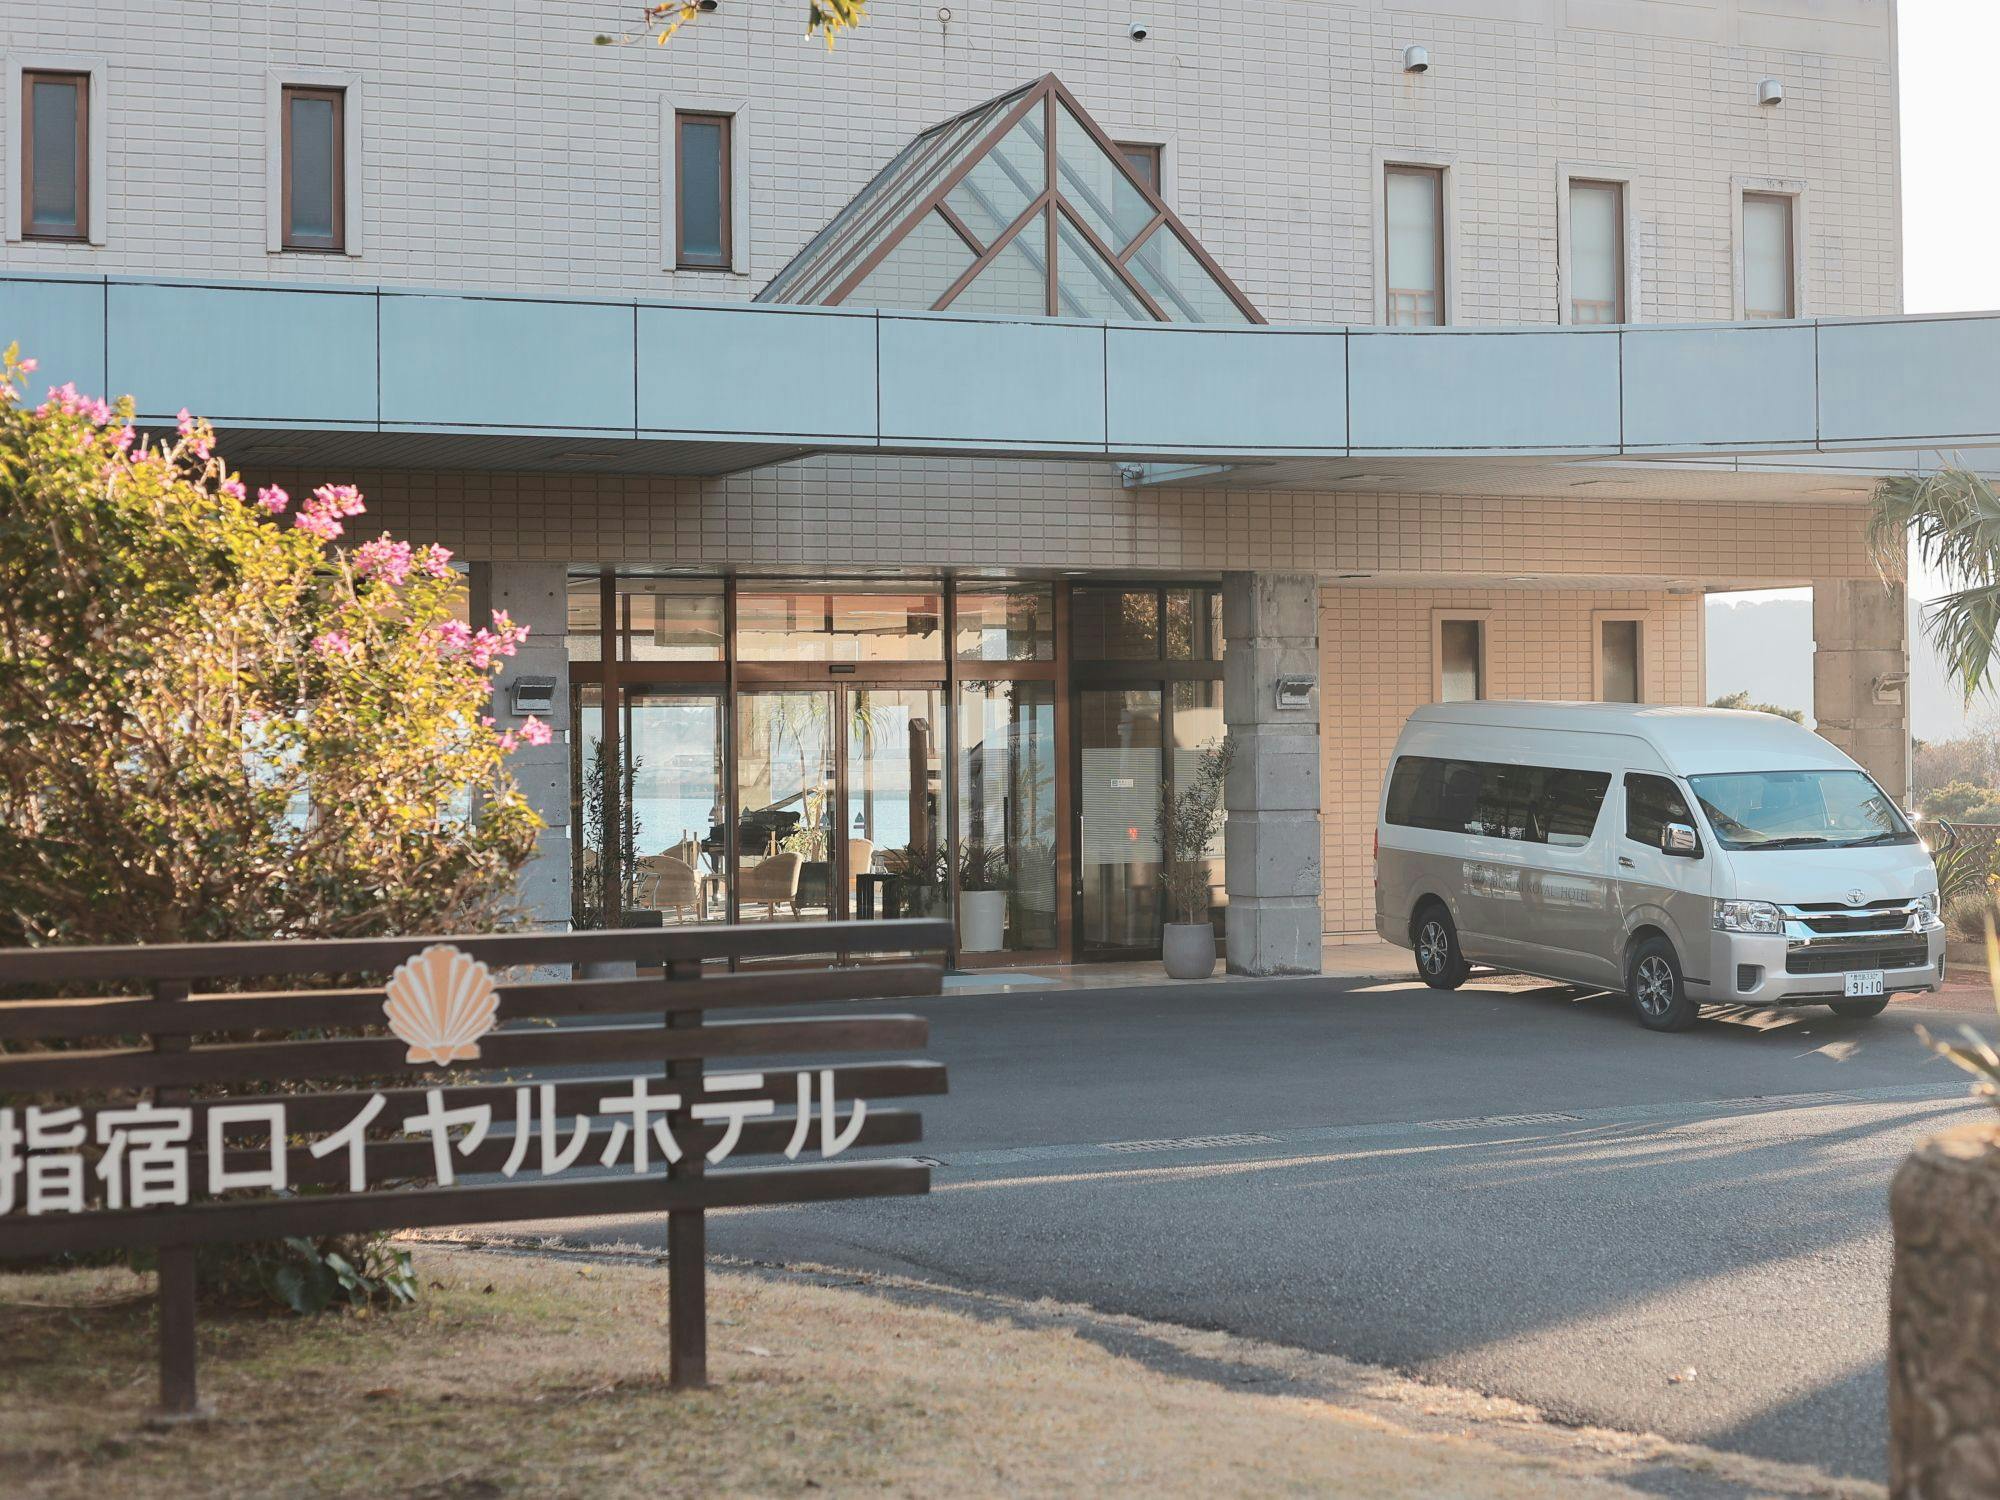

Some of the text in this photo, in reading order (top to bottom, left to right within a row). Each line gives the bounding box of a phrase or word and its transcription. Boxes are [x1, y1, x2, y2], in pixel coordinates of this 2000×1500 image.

[1526, 881, 1554, 897] ROYAL
[1561, 887, 1590, 902] HOTEL
[1853, 981, 1882, 995] 91-10
[0, 1070, 867, 1216] 指宿ロイヤルホテル
